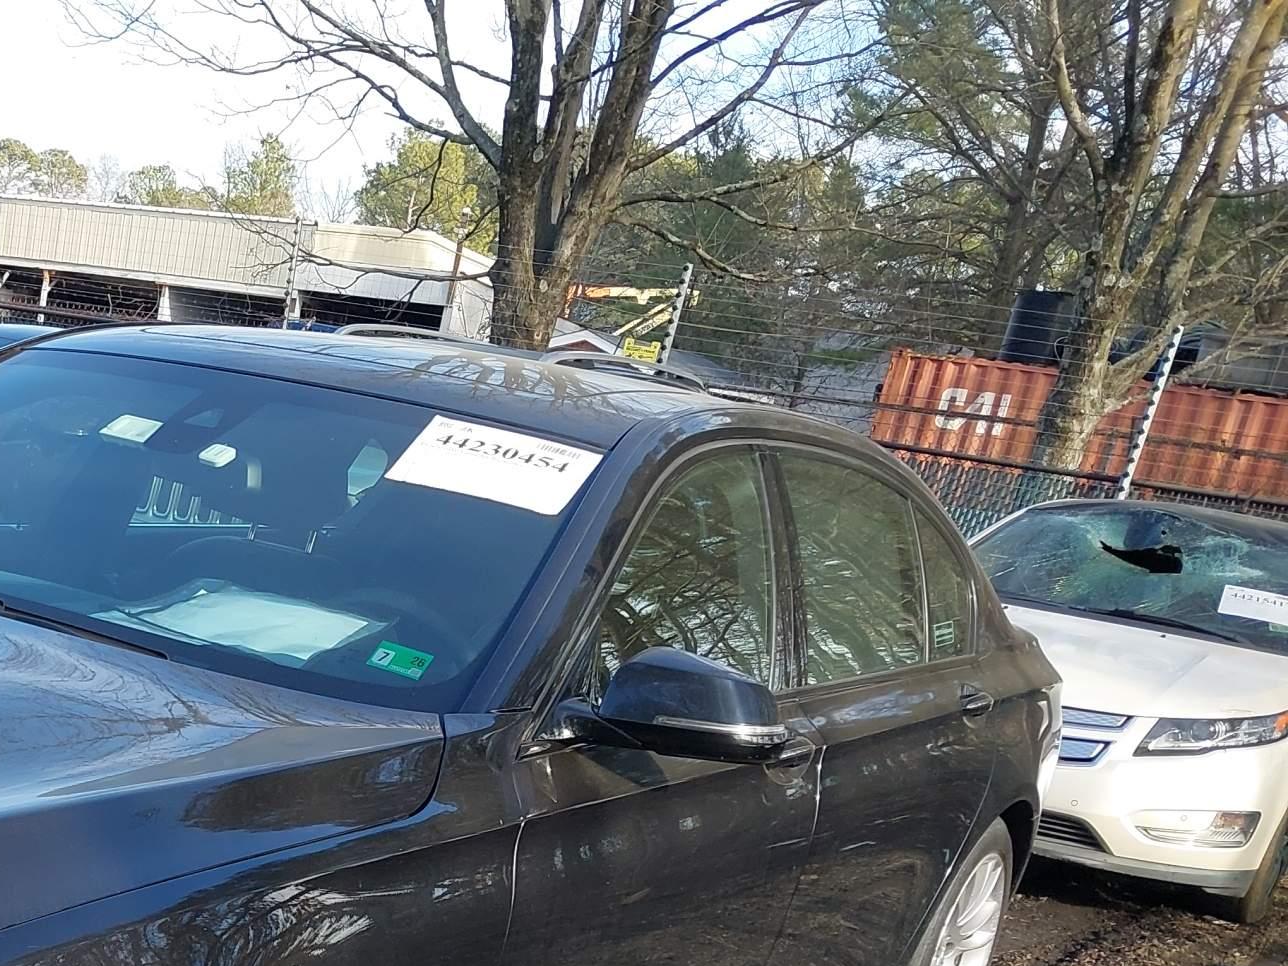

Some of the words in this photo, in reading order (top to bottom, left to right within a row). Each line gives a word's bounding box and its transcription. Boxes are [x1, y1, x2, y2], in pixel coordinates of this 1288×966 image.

[935, 388, 1012, 436] CAI
[436, 435, 569, 472] 44230454
[377, 651, 390, 662] 7
